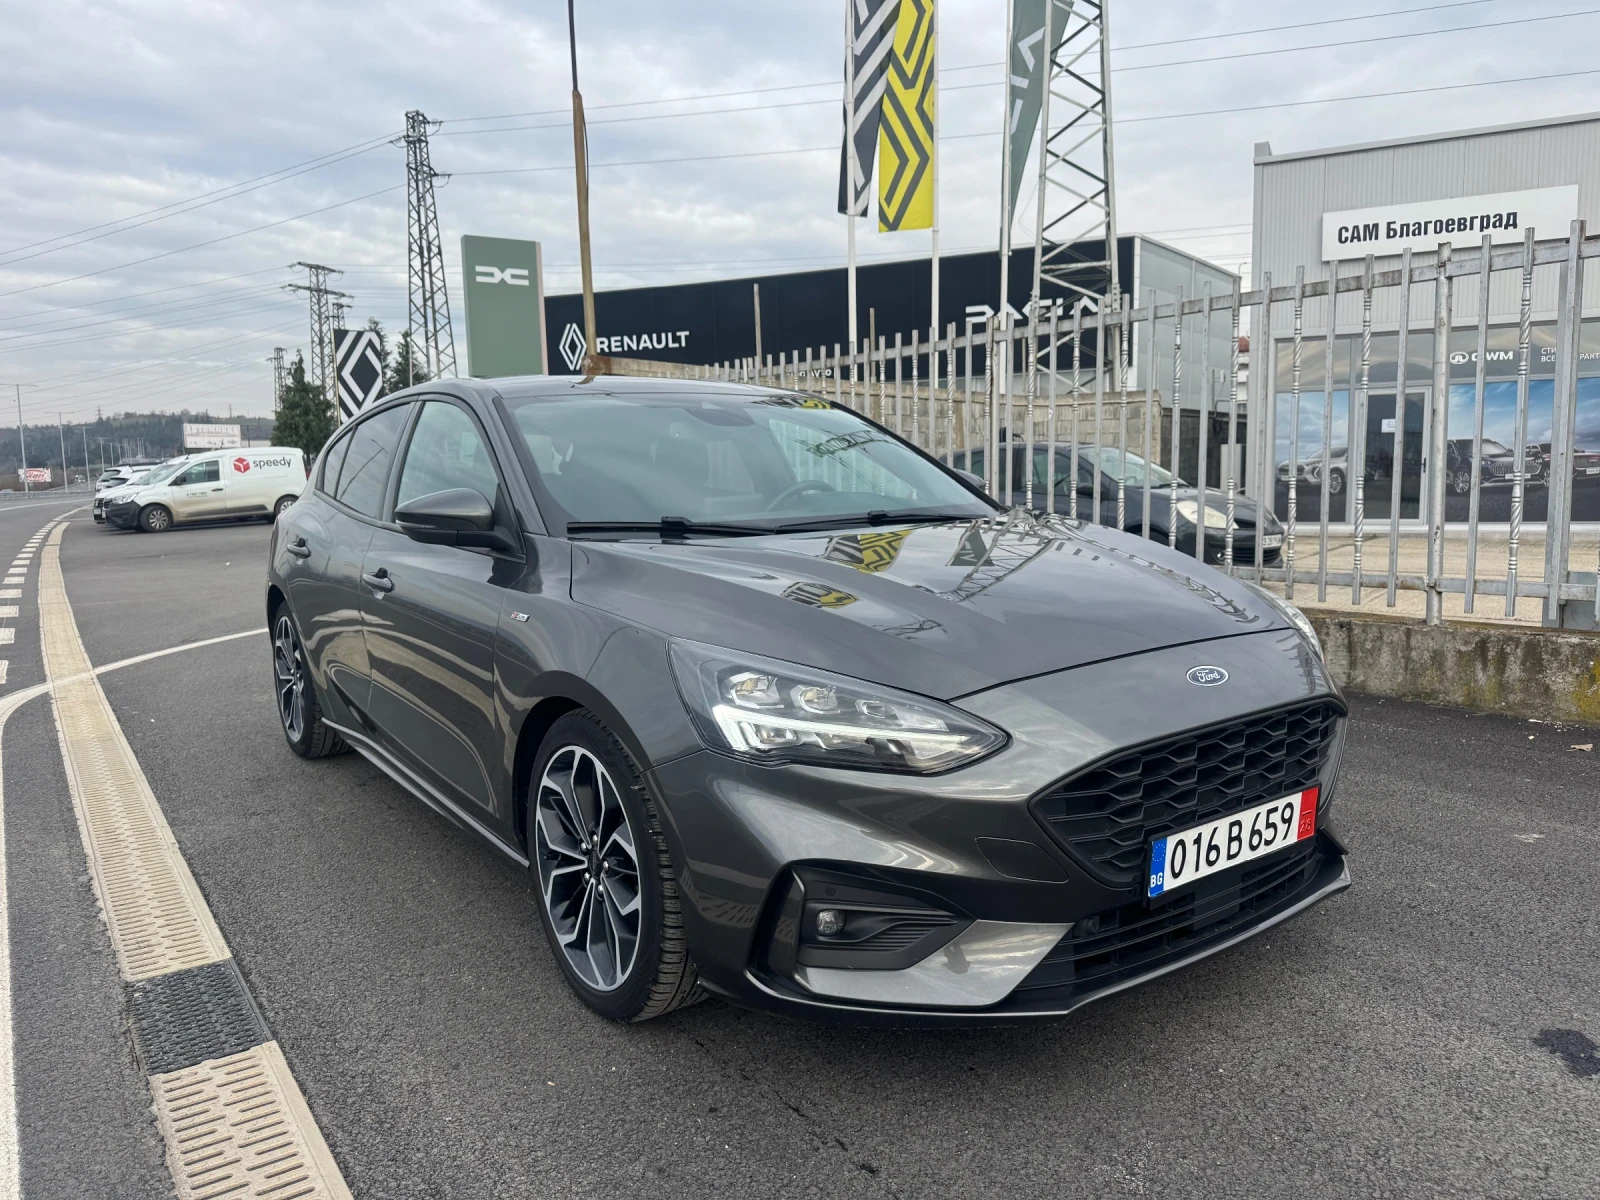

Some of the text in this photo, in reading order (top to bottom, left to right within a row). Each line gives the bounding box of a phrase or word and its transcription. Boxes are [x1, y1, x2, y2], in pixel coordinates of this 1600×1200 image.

[1337, 211, 1518, 244] САМ Благоевград
[596, 331, 690, 353] RENAULT
[253, 457, 292, 469] speedy
[1196, 669, 1221, 682] Ford
[1150, 872, 1163, 888] BG
